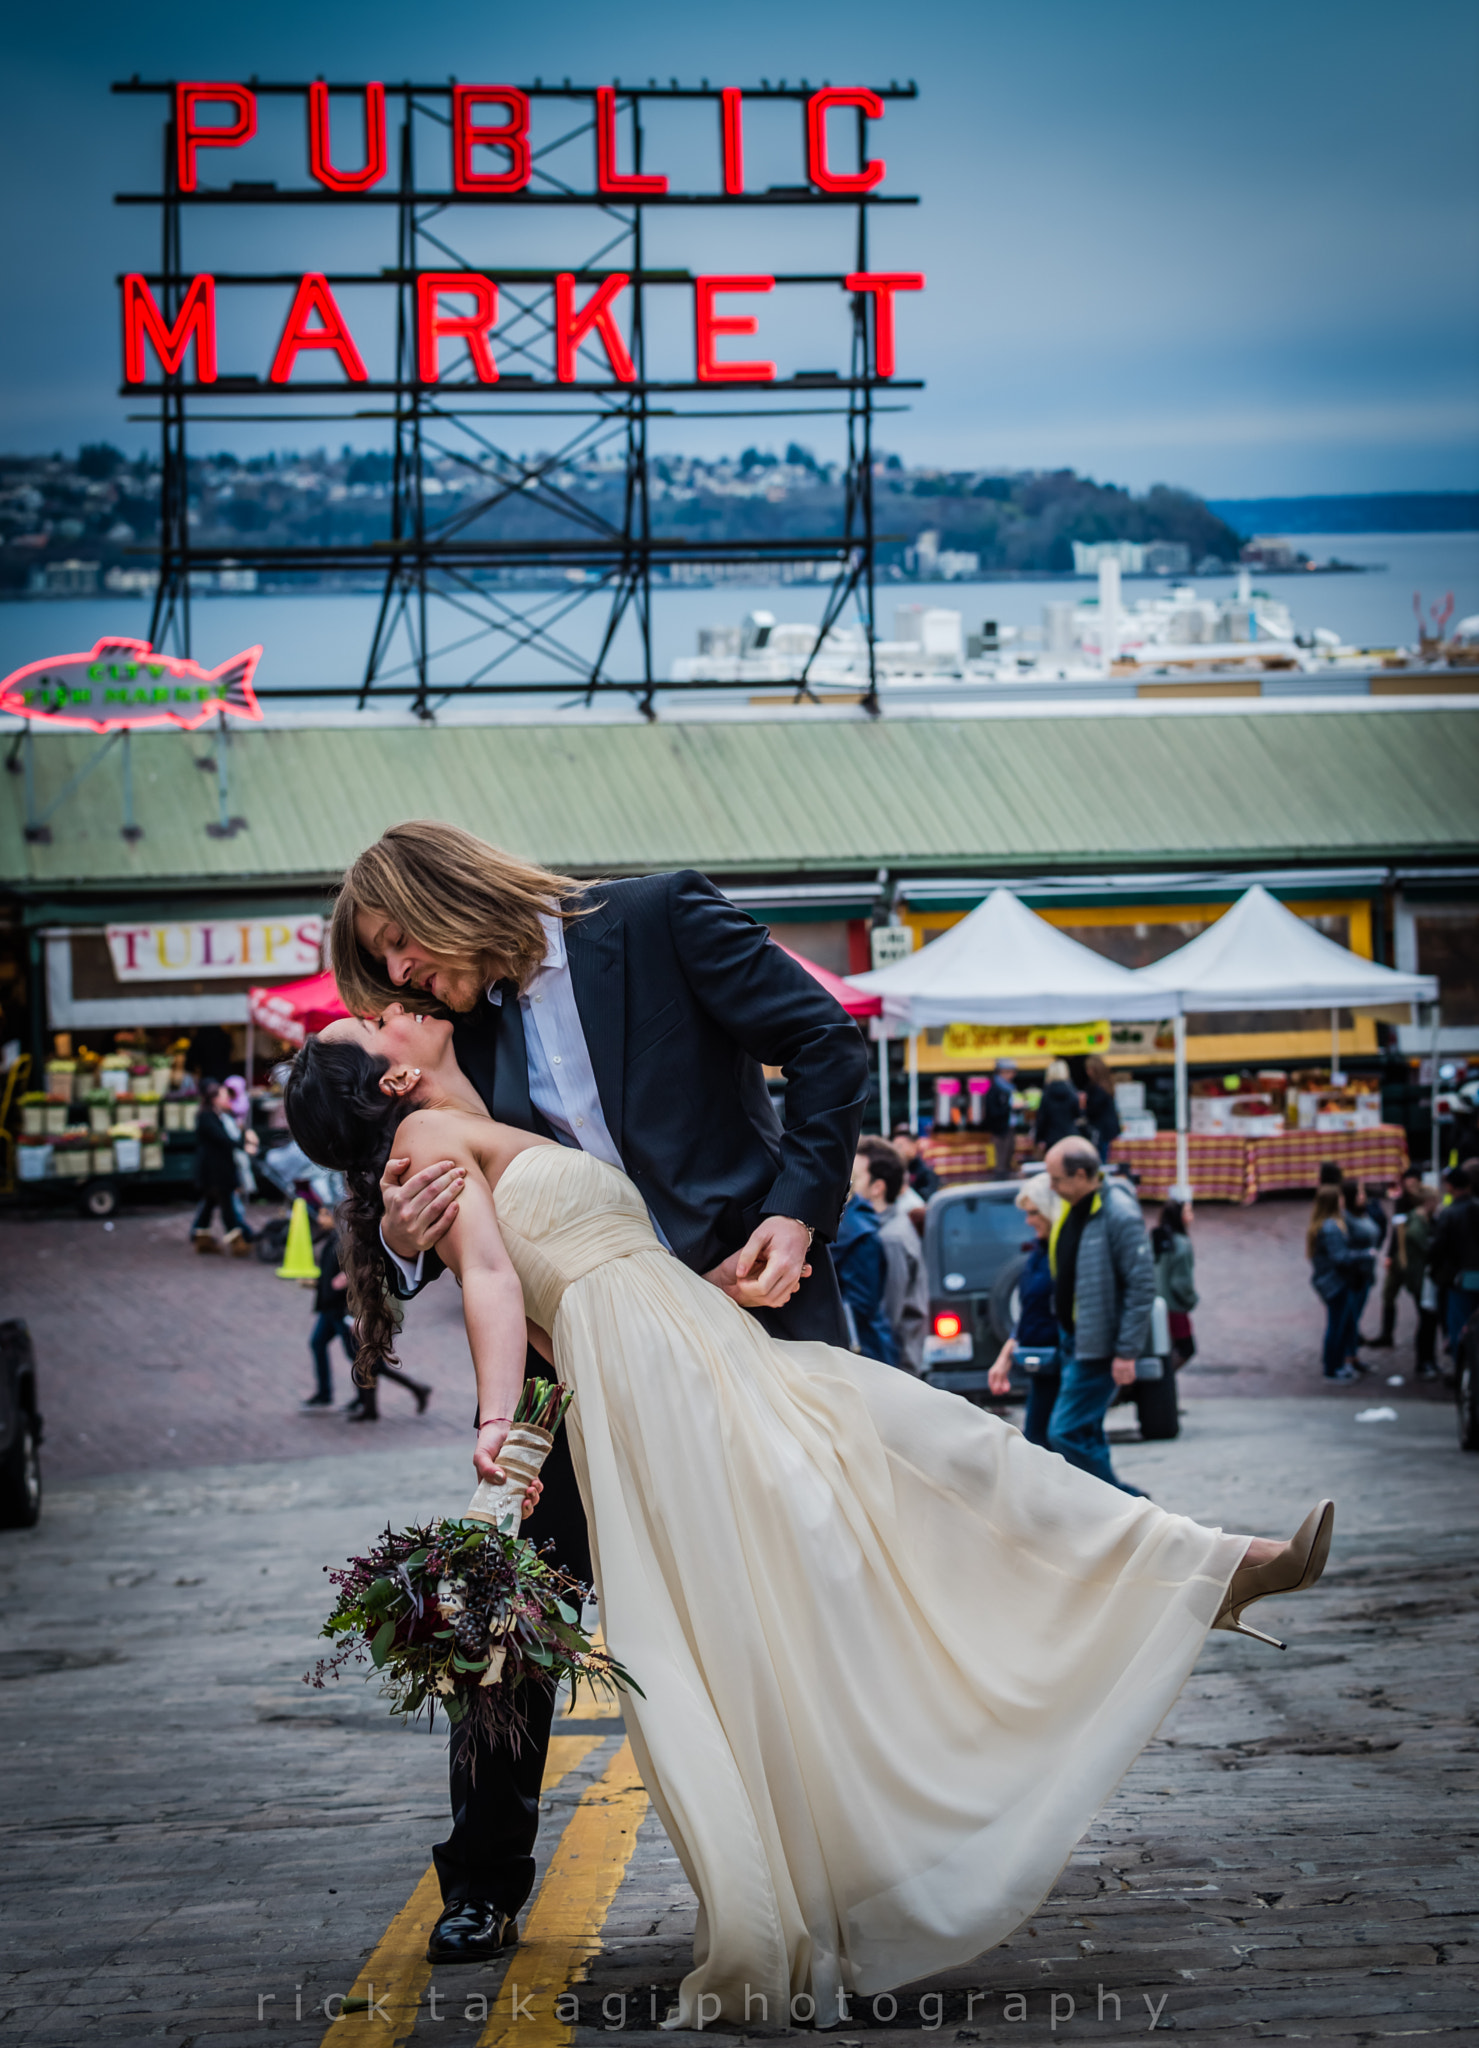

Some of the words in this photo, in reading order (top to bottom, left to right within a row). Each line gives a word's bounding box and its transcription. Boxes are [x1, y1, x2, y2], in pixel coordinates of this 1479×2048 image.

[174, 80, 887, 194] PUBLIC
[122, 271, 925, 384] MARKET
[87, 661, 167, 683] CITY
[103, 685, 229, 706] MARKET
[107, 921, 320, 970] TULIPS
